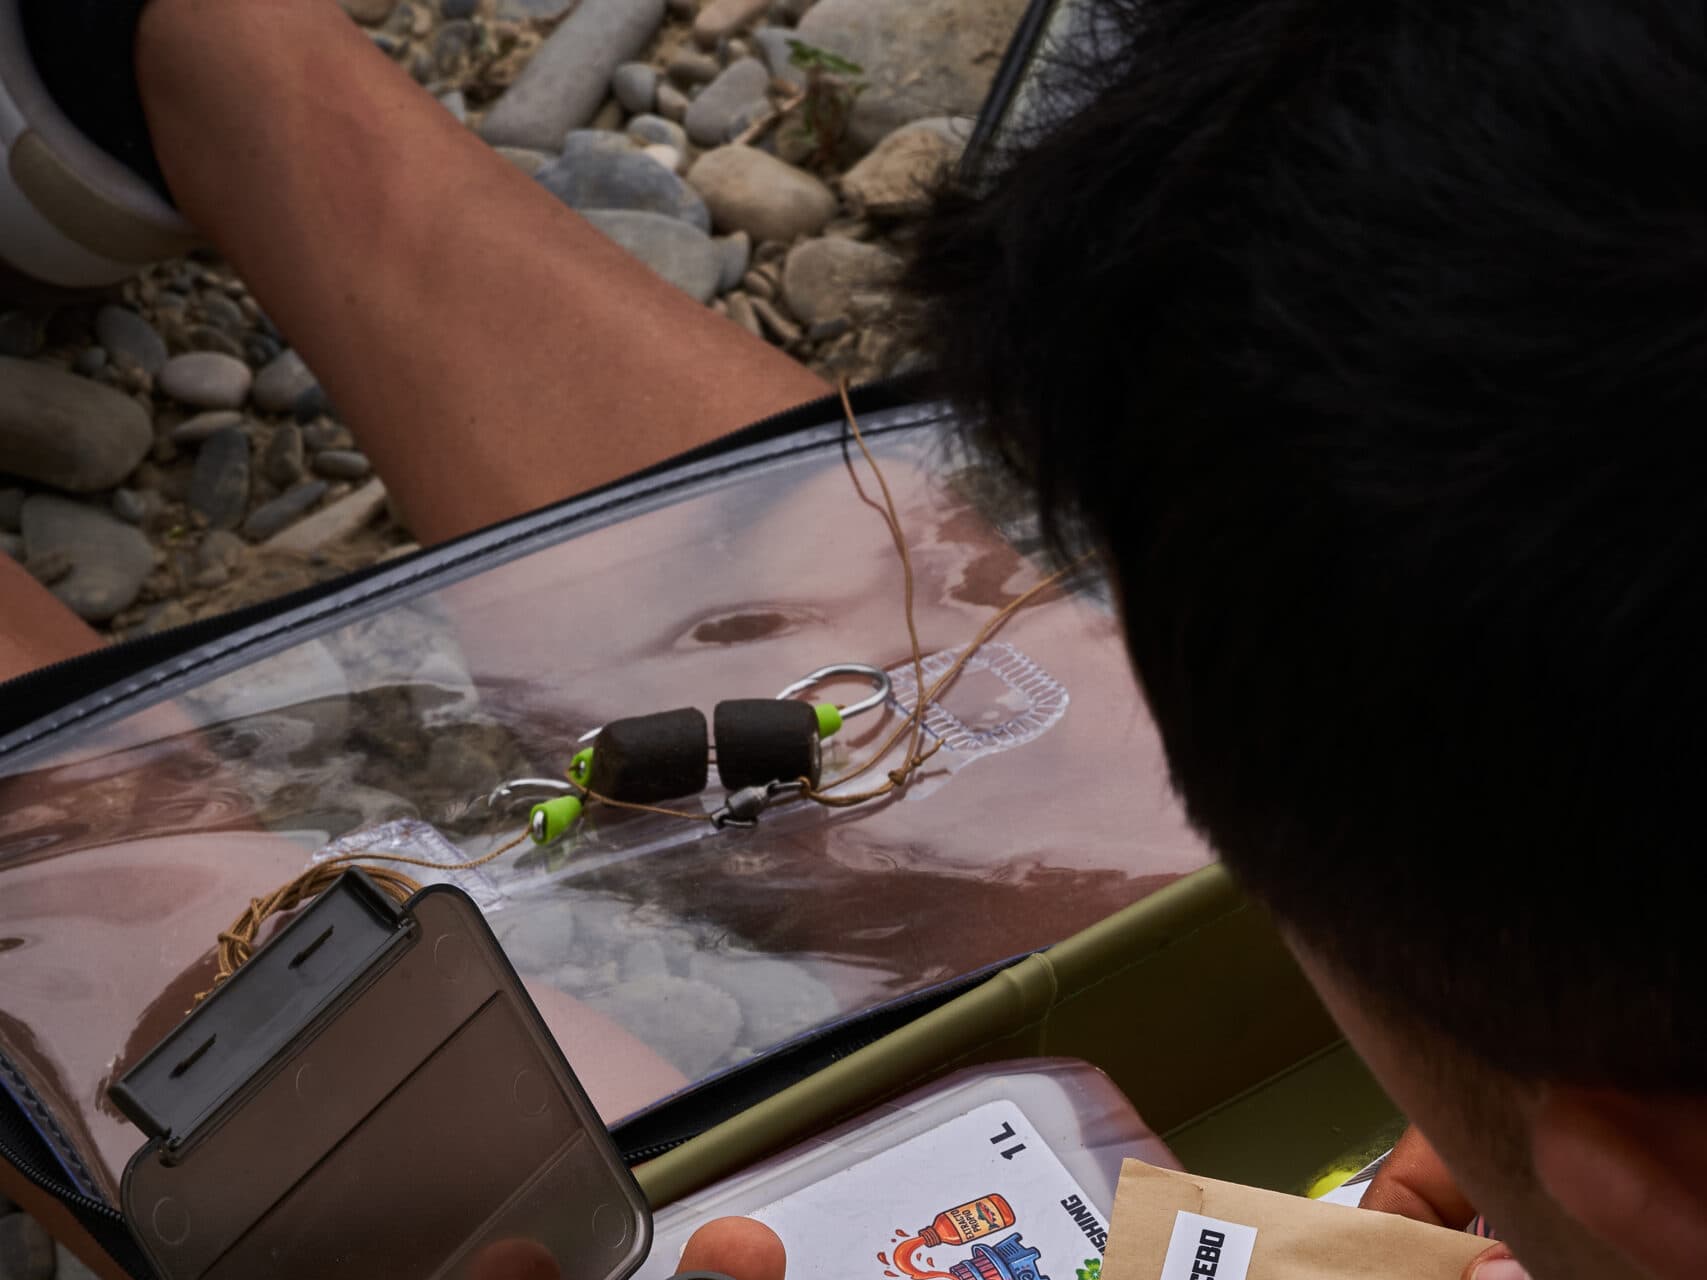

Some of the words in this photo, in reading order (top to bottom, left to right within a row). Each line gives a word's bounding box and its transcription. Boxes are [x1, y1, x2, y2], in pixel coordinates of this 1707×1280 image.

[990, 1121, 1016, 1144] L
[1000, 1143, 1026, 1160] 1
[950, 1209, 975, 1240] EXTRACTO
[962, 1209, 981, 1233] PROPIO
[1060, 1194, 1108, 1256] SHING
